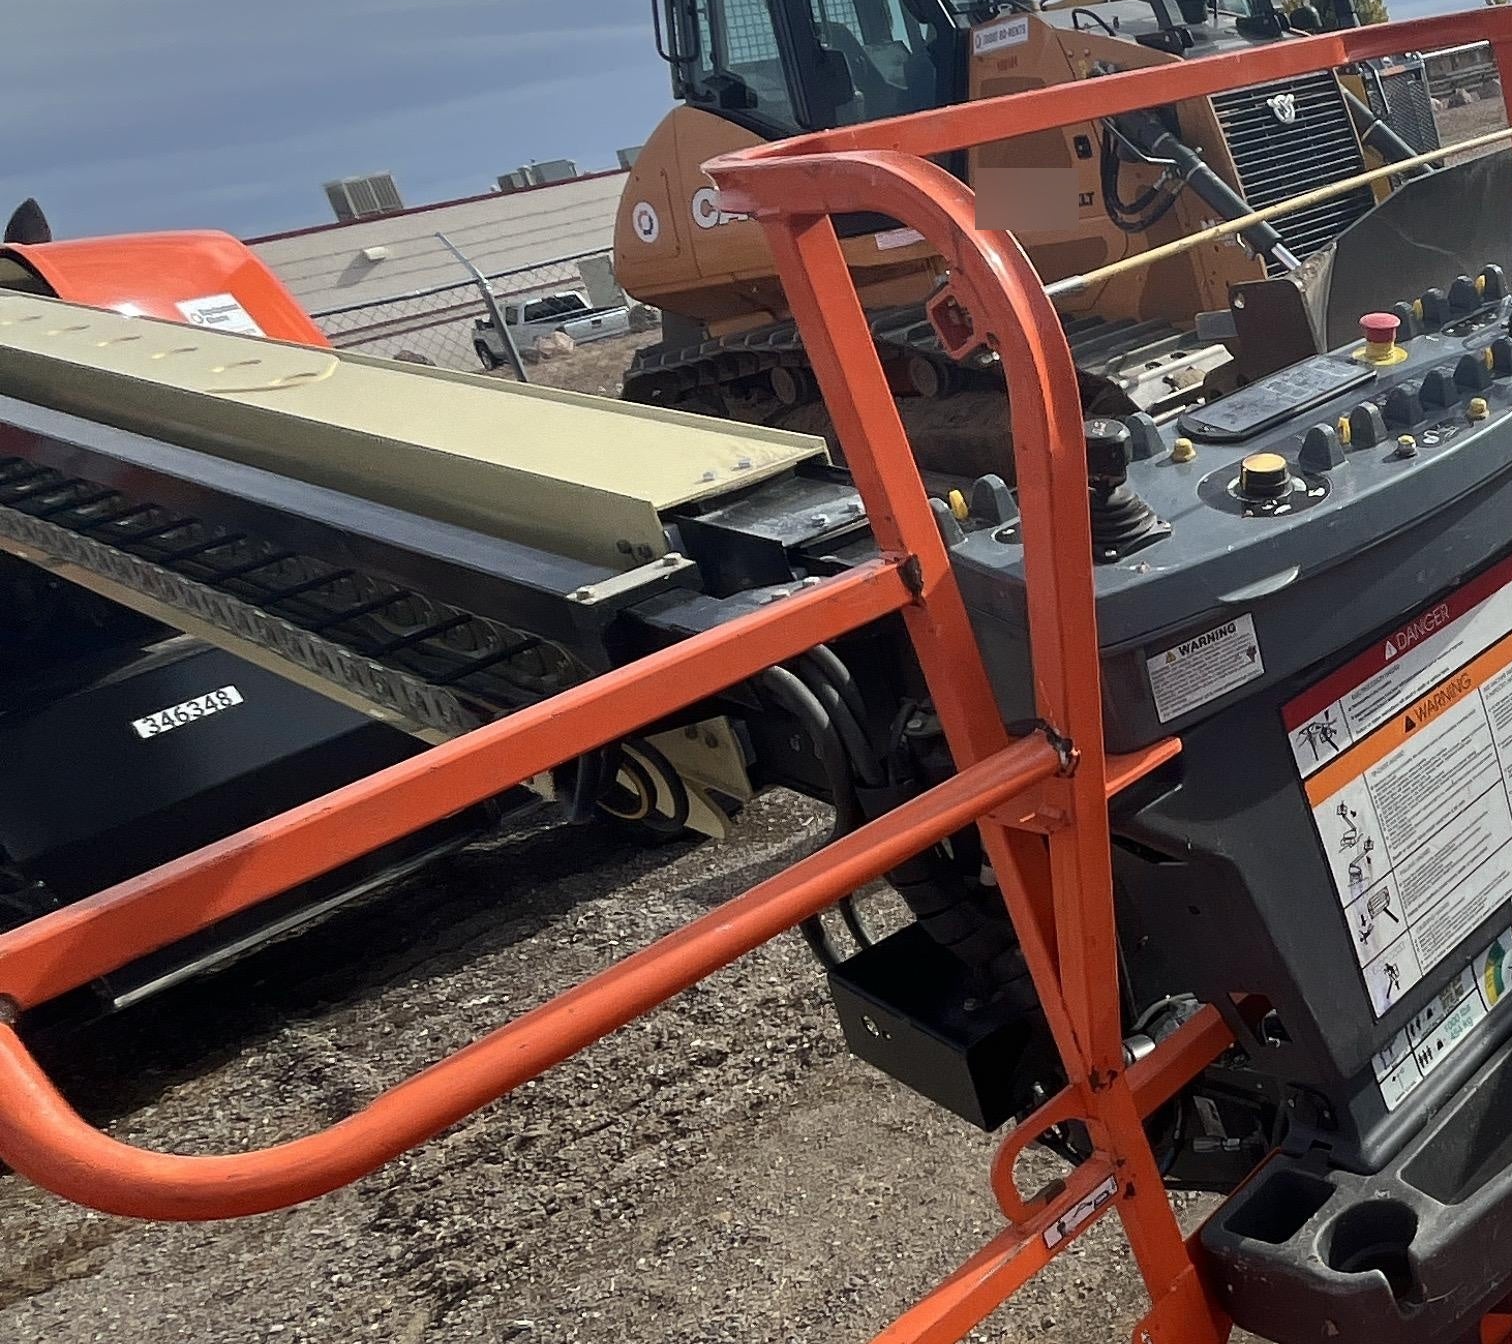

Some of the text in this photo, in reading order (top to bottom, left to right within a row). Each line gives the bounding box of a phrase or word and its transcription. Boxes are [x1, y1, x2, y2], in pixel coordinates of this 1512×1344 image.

[1179, 622, 1237, 656] WARNING
[1395, 603, 1450, 651] DANGER
[142, 690, 233, 734] 346348
[1414, 672, 1472, 722] WARNING
